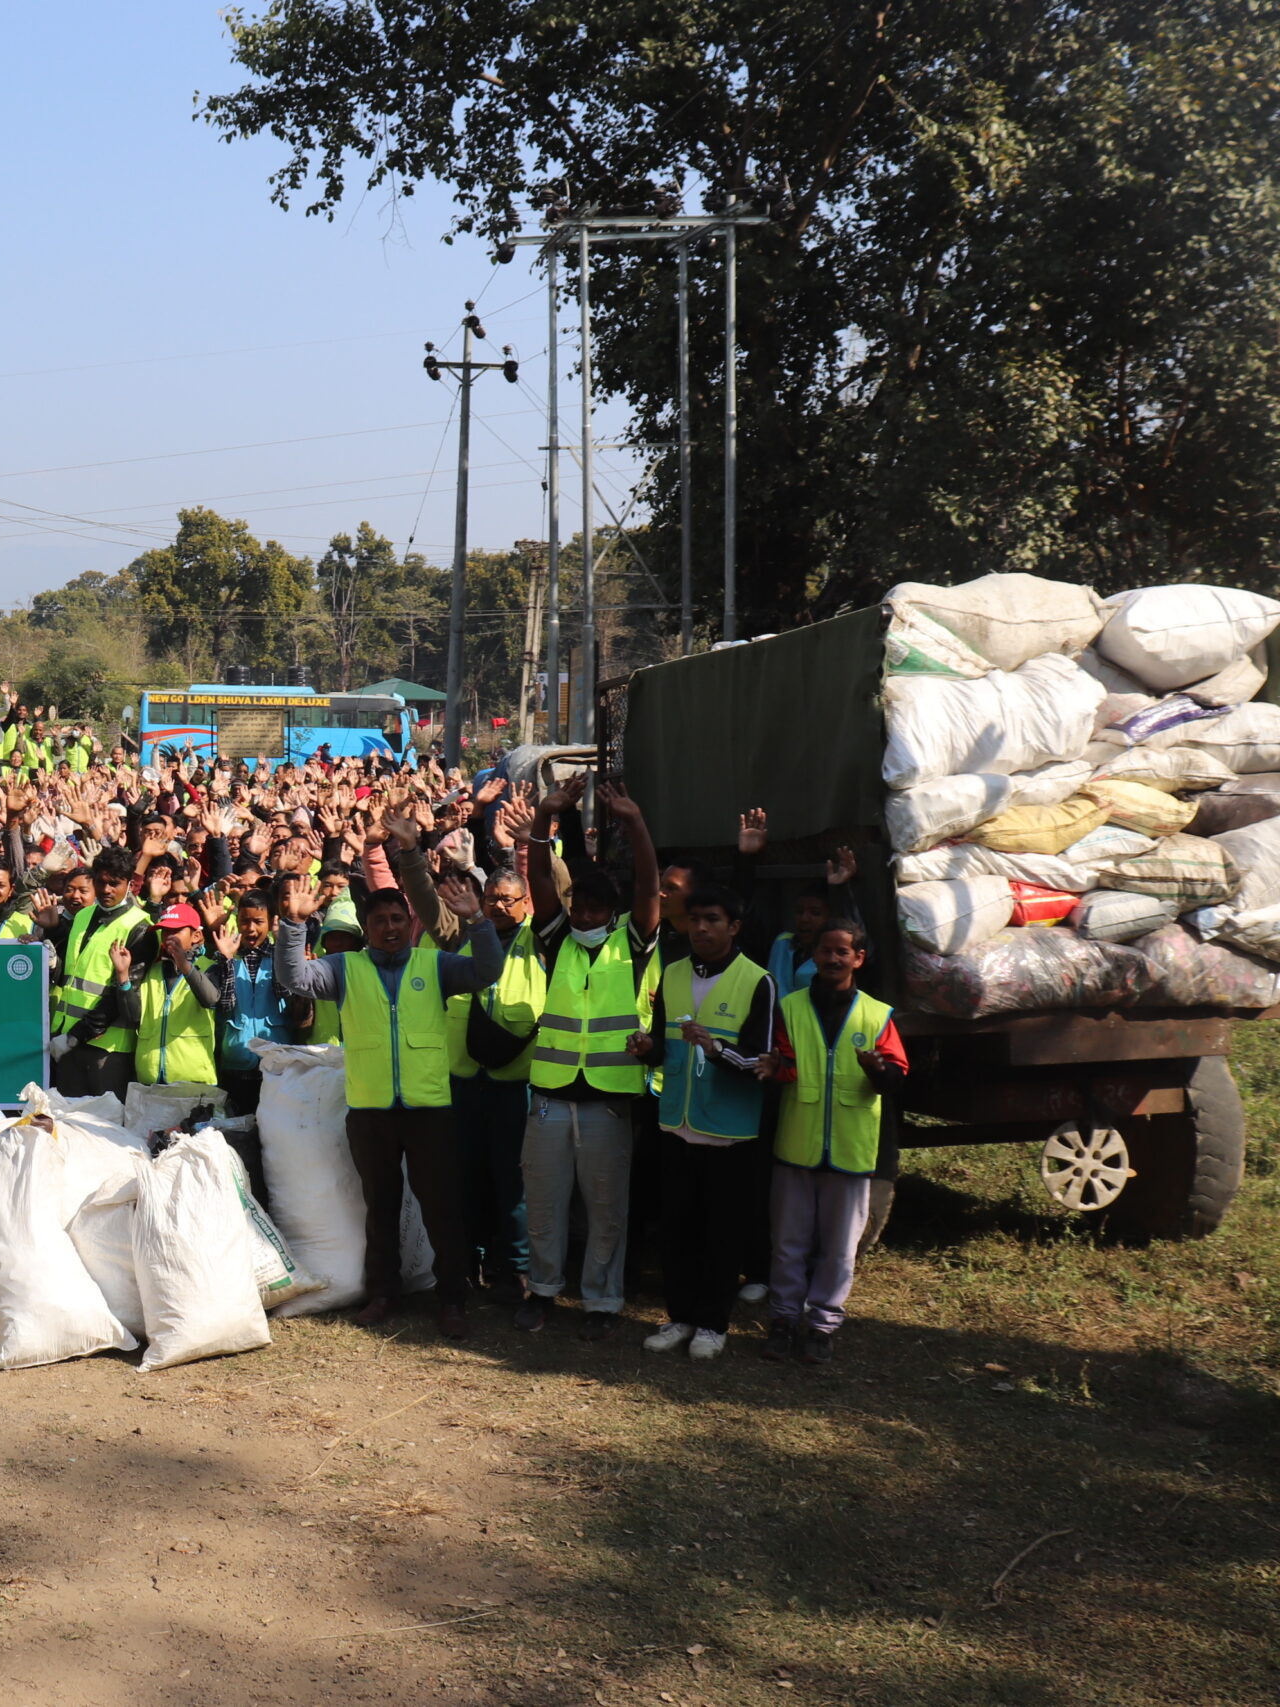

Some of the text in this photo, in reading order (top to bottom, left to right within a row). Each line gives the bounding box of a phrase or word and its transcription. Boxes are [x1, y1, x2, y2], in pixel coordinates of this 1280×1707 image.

[148, 694, 169, 703] NEW
[217, 695, 251, 705] SHUVA
[253, 696, 286, 705] LAXMI
[288, 697, 331, 706] DELUXE
